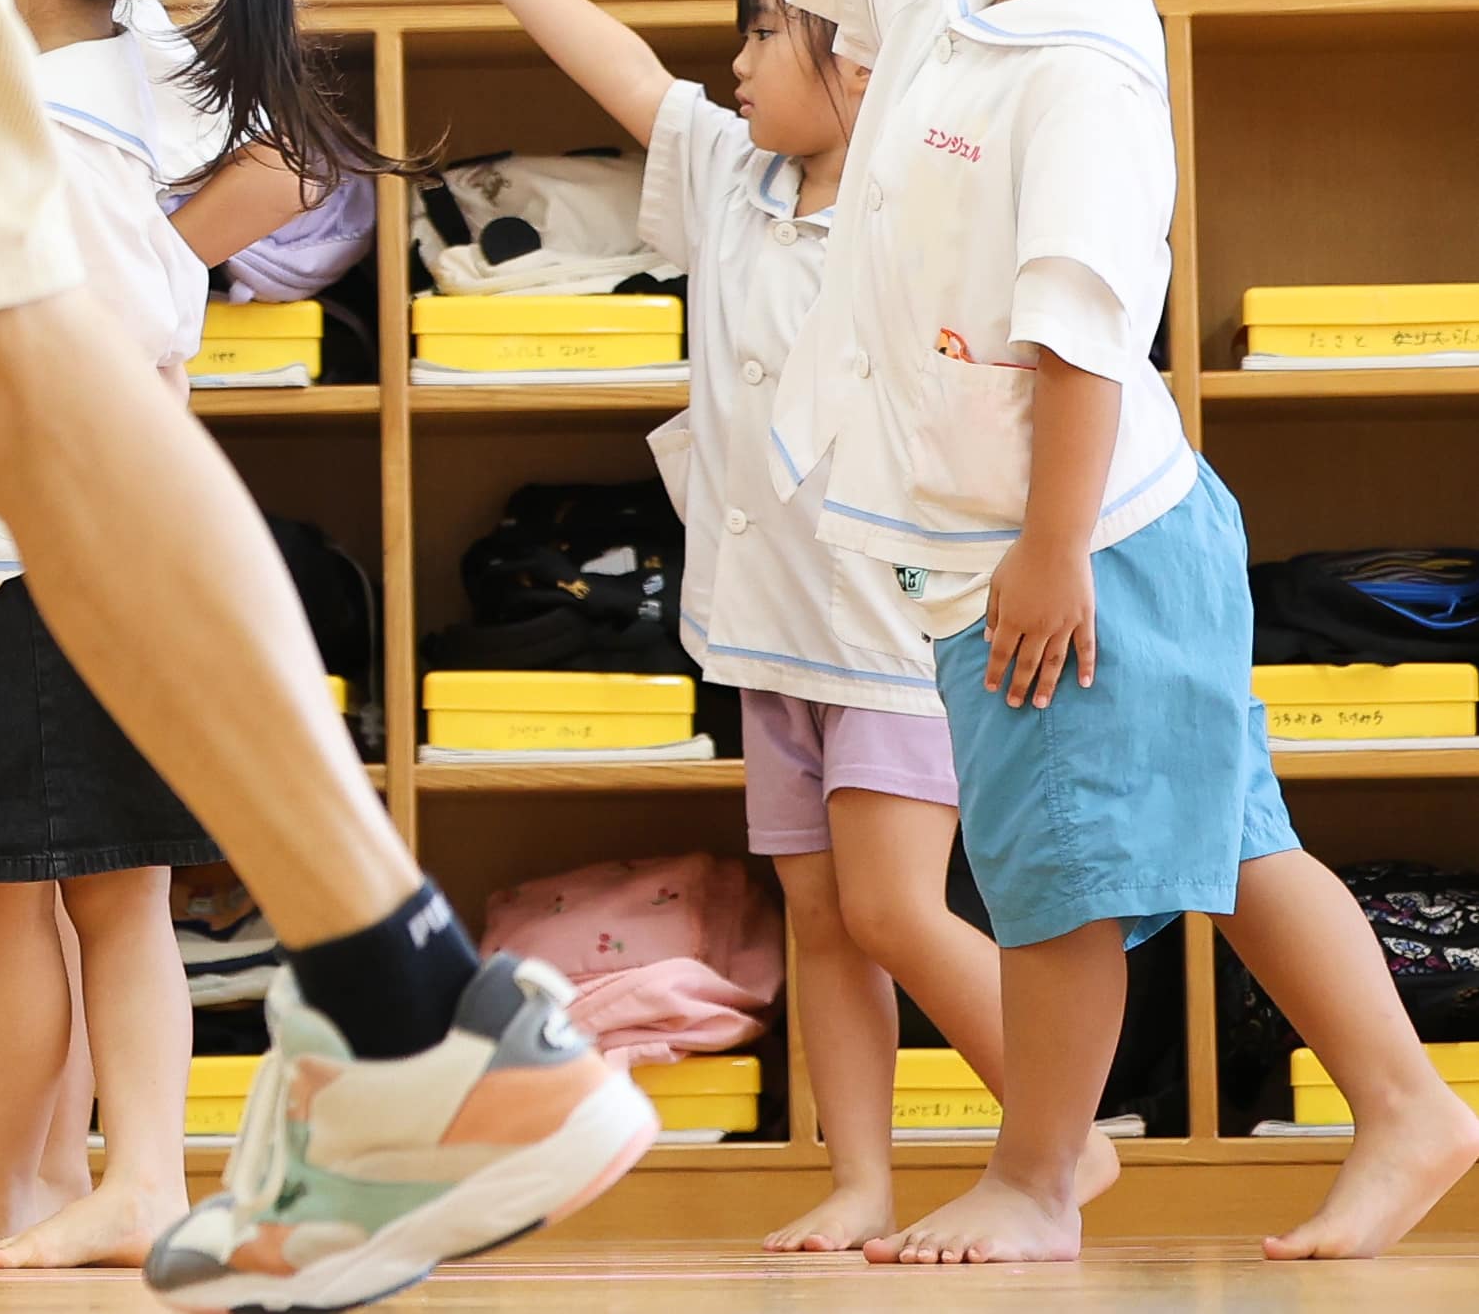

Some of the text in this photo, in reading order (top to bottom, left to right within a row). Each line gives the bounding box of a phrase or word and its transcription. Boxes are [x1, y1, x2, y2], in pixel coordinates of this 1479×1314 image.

[923, 127, 982, 164] エンジェル
